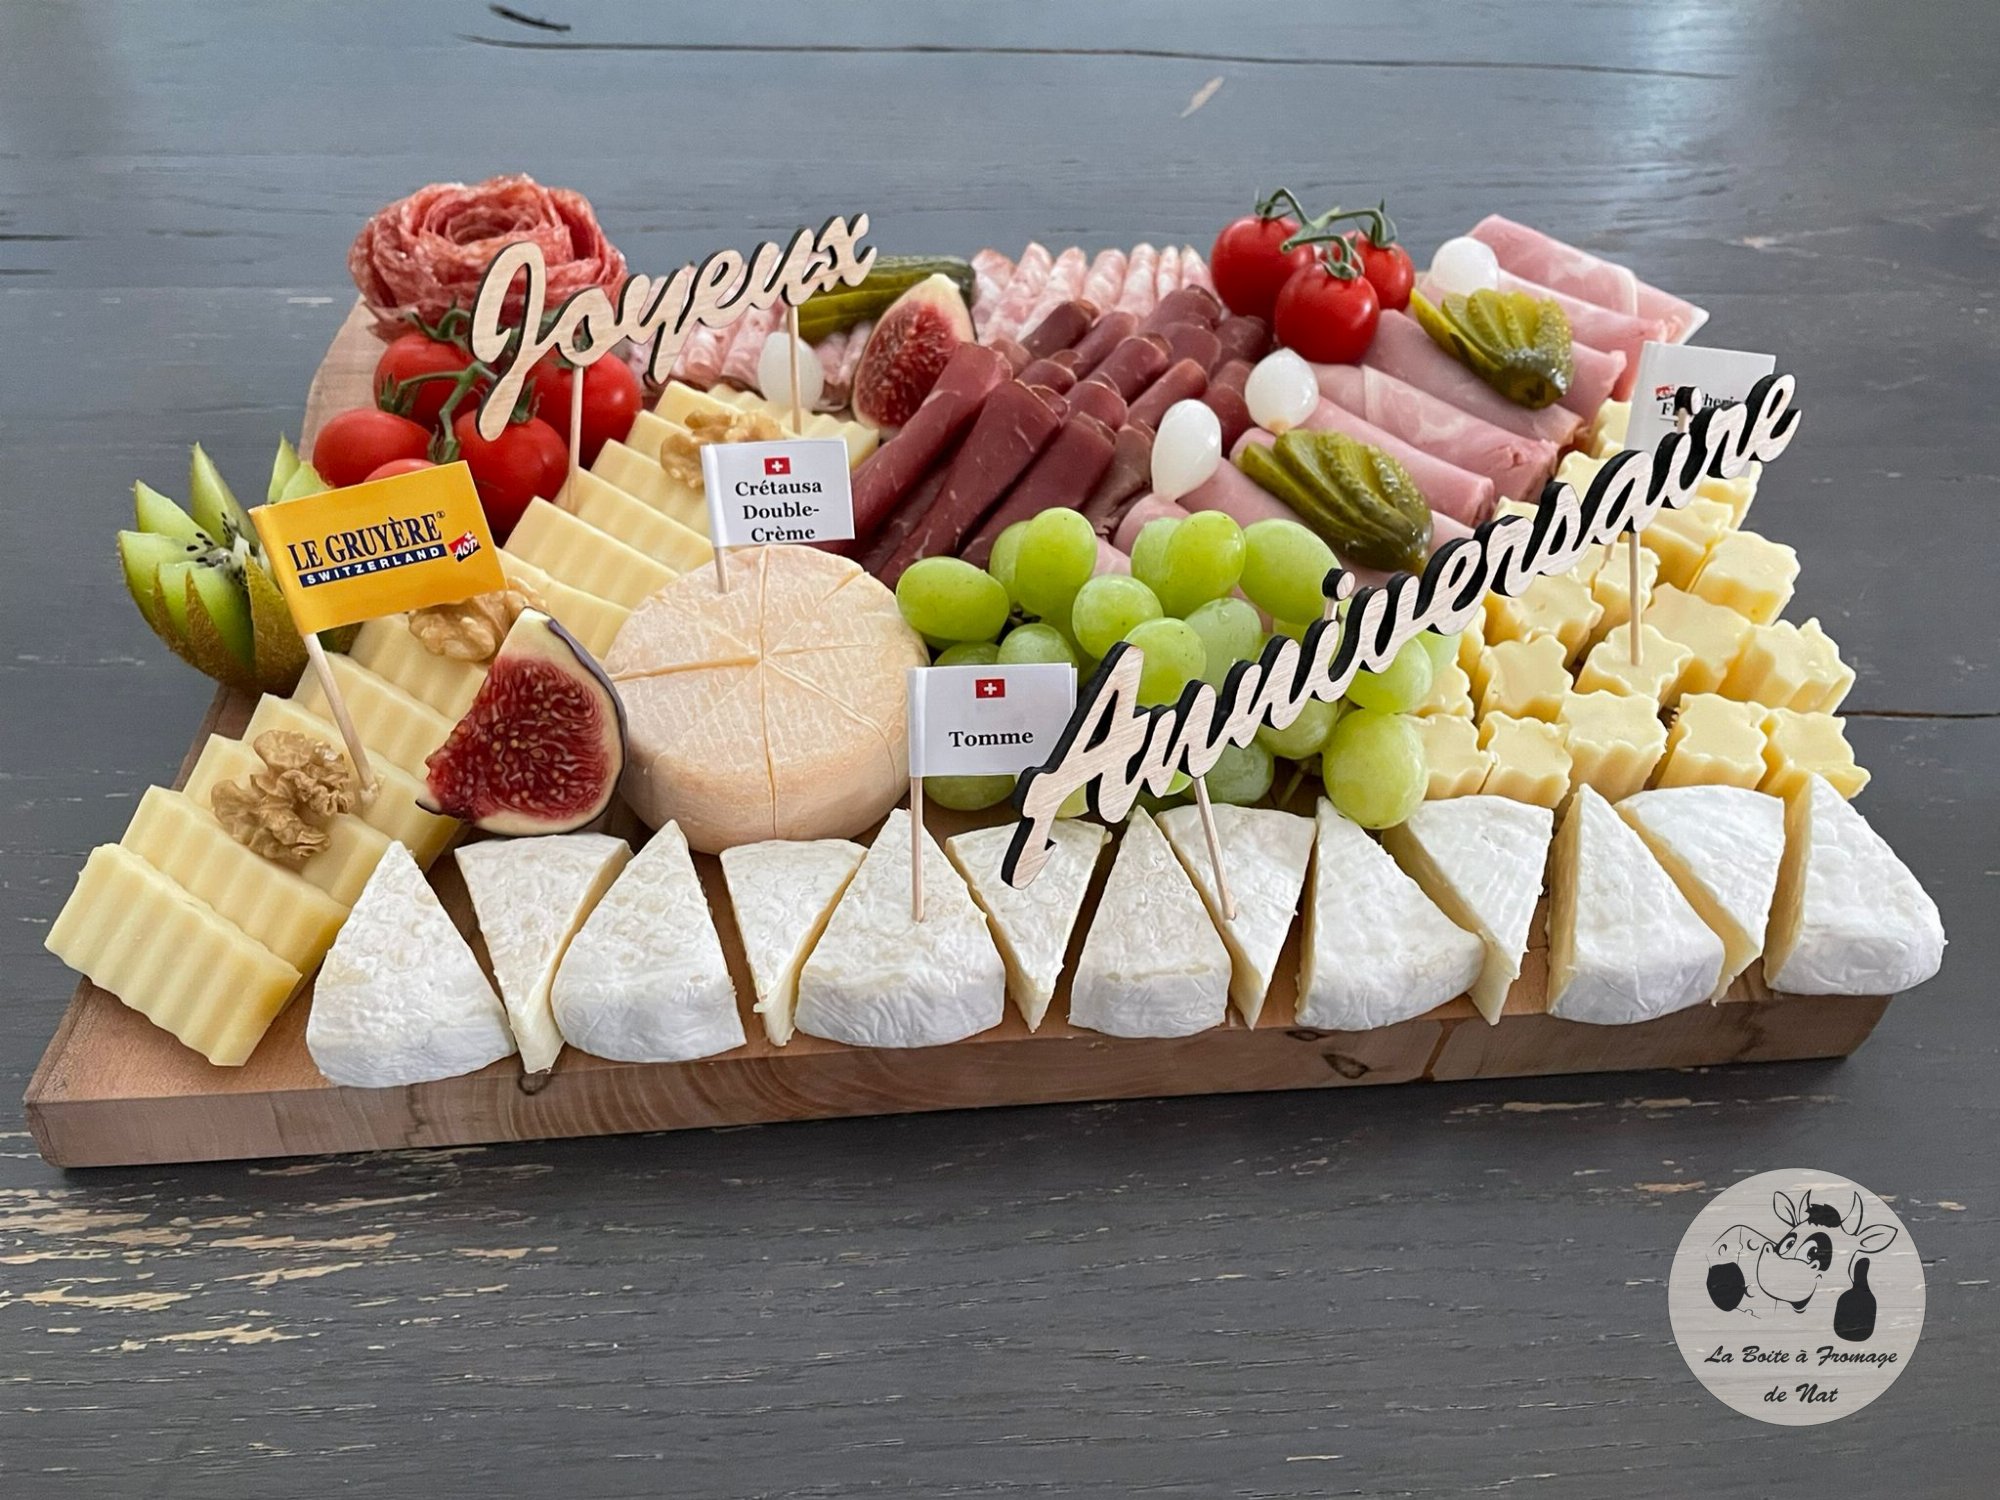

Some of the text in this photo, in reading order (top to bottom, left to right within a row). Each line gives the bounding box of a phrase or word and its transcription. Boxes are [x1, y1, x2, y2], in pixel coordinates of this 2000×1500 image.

[469, 213, 877, 442] Joyeux
[735, 480, 822, 496] Crétausa
[743, 502, 819, 519] Double-
[751, 526, 815, 542] Crème
[287, 540, 324, 571] LE
[306, 546, 440, 585] SWITZERLAND
[1001, 374, 1801, 889] Anniversaire
[948, 731, 1034, 747] Tomme
